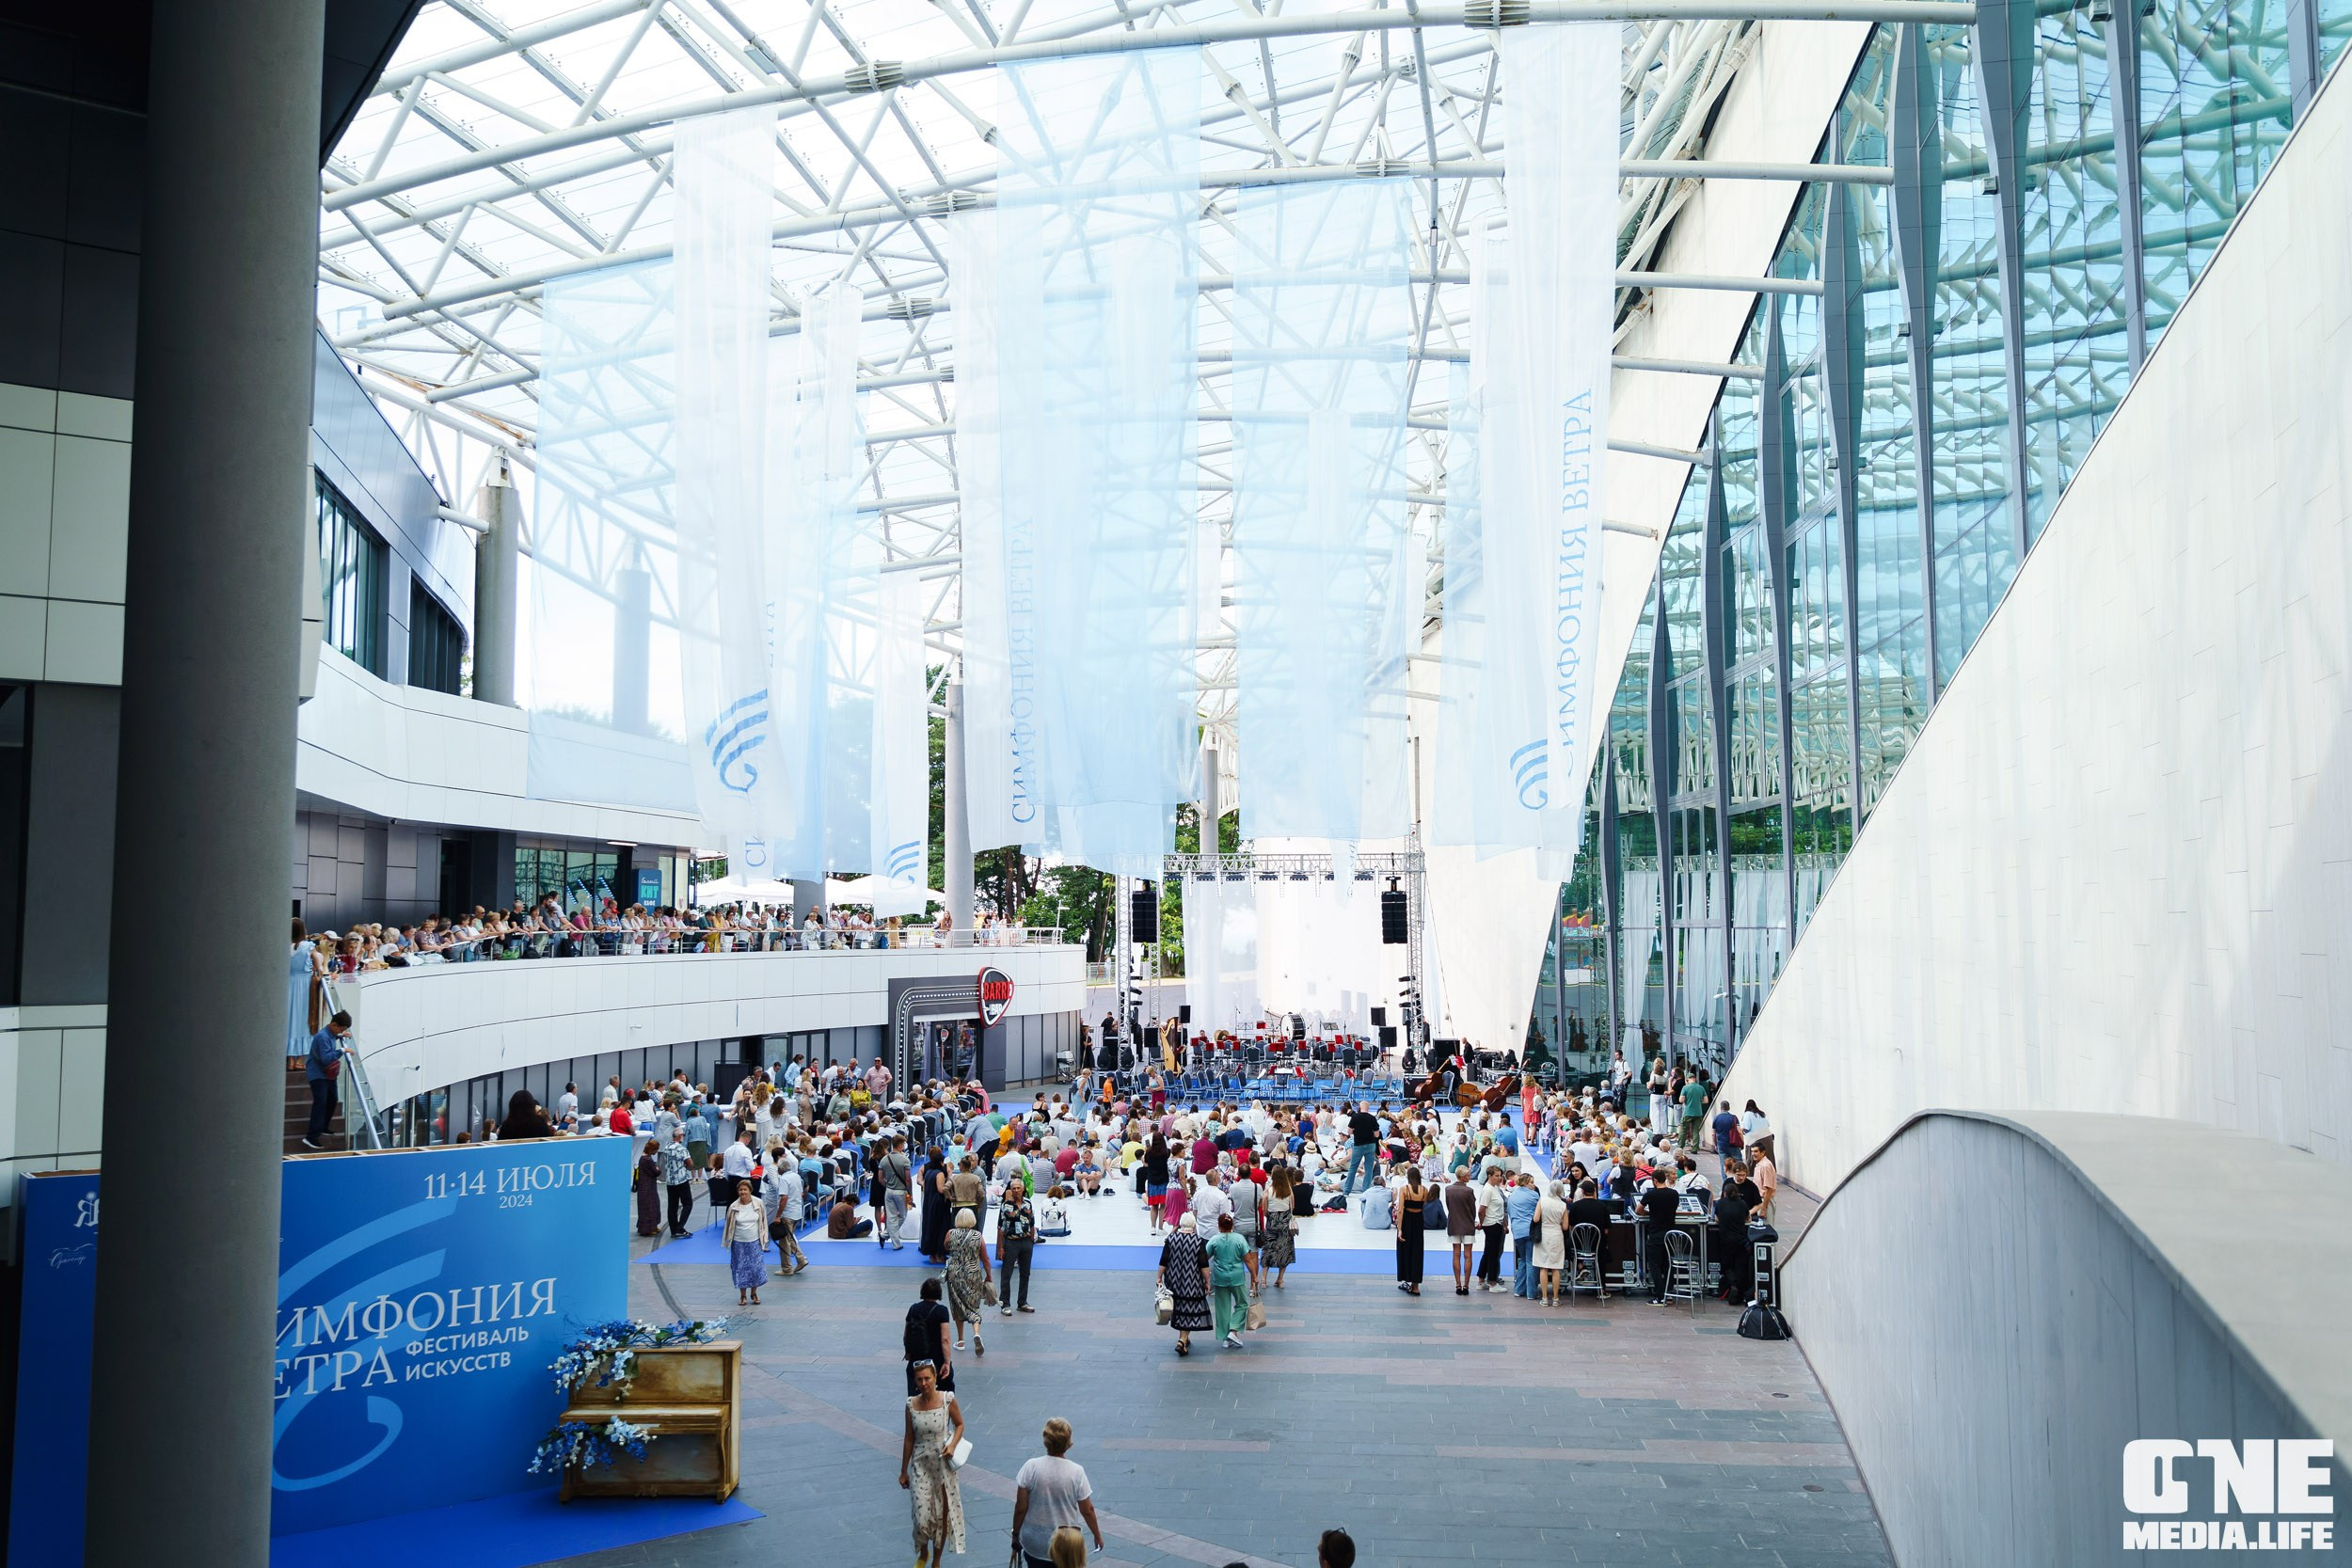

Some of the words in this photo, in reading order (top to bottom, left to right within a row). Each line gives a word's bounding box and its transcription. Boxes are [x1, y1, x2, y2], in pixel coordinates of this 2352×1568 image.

[1562, 388, 1593, 515] ВЕТРА
[1010, 517, 1035, 616] ВЕТРА
[641, 885, 659, 898] КИТ
[496, 1161, 596, 1194] ИЮЛЯ
[499, 1193, 533, 1209] 2024
[275, 1277, 557, 1350] ИМФОНИЯ
[405, 1325, 530, 1356] ФЕСТИВАЛЬ
[273, 1345, 398, 1400] ЕТРА
[405, 1351, 512, 1381] ИСКУССТВ
